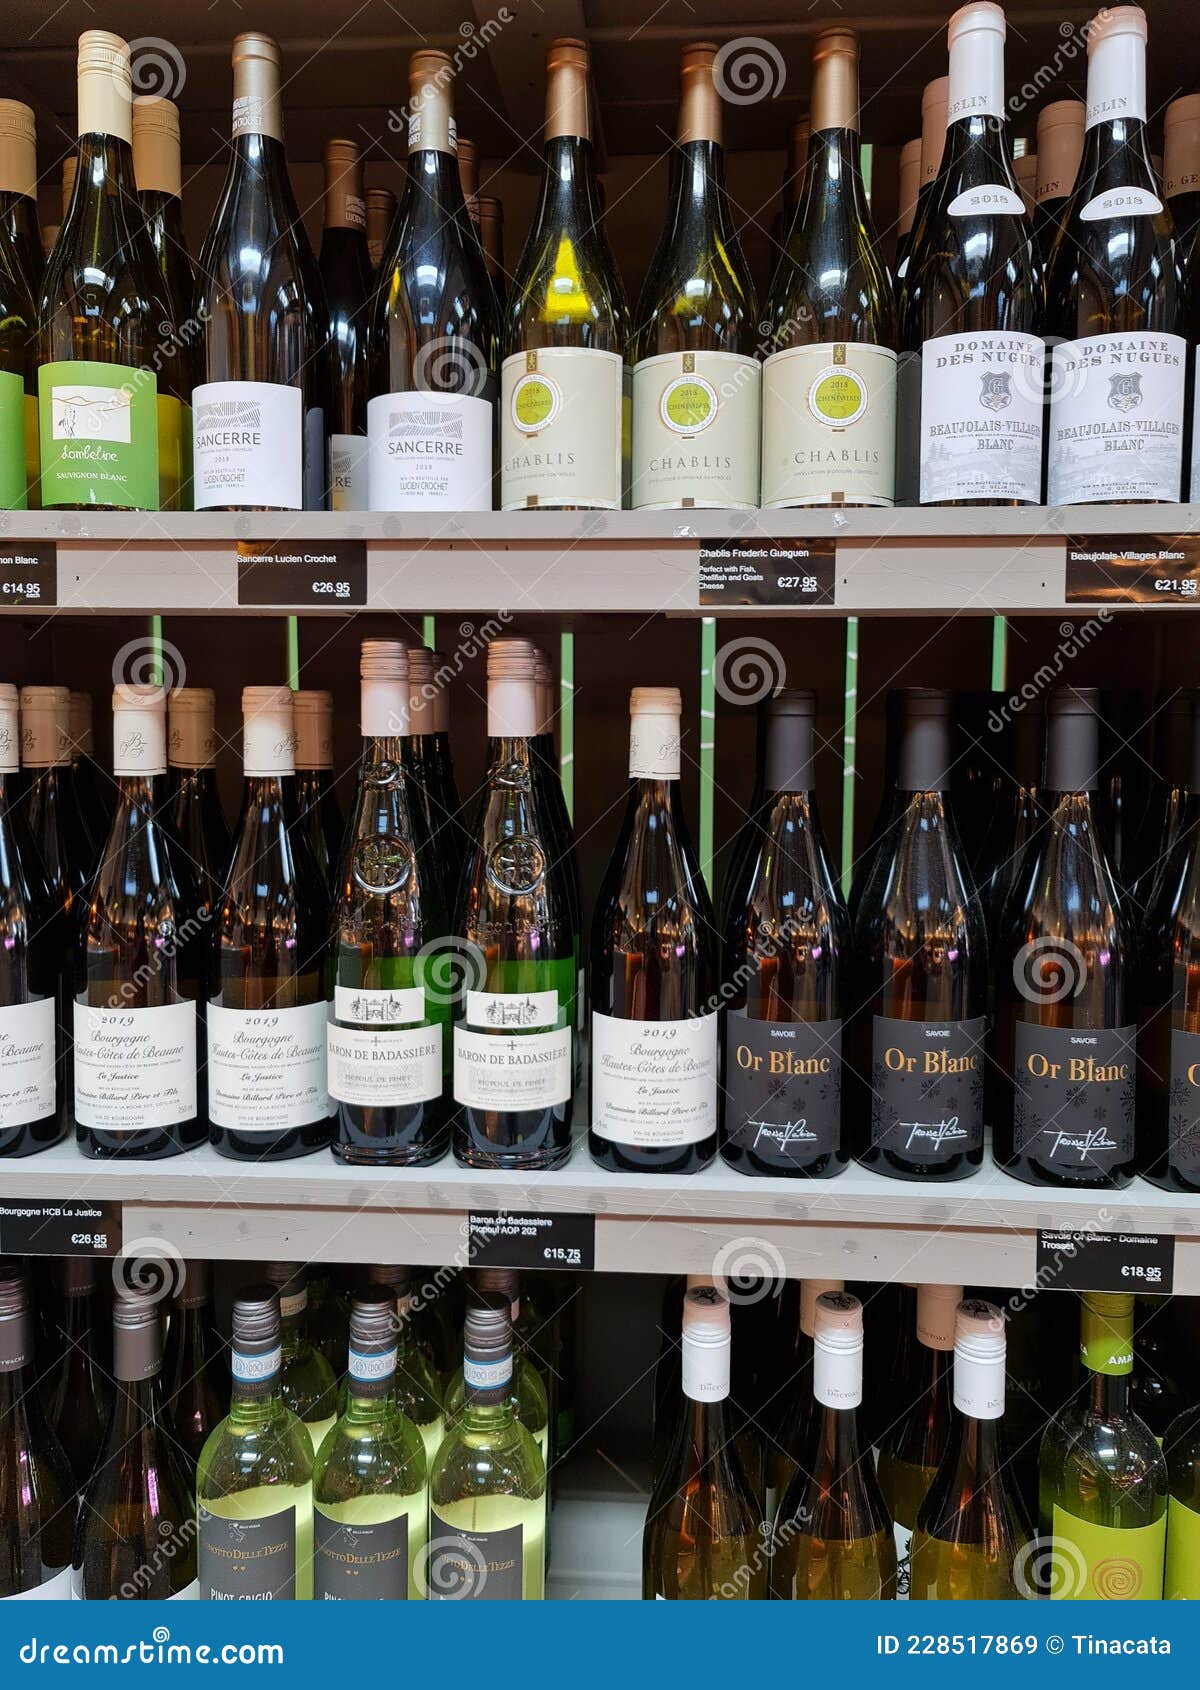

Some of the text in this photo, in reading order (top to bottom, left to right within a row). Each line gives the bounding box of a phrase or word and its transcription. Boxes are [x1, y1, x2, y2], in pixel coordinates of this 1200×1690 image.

[954, 339, 1033, 353] DOMAINE
[1082, 340, 1169, 356] DOMAINE
[936, 351, 1041, 368] DES NUGUES
[1065, 351, 1180, 372] DES NUGUES
[195, 432, 262, 449] SANCERRE
[976, 438, 1014, 450] BLANC
[1103, 439, 1145, 452] BLANC
[388, 440, 464, 456] SANCERRE
[504, 452, 576, 472] CHABLIS
[794, 449, 879, 464] CHABLIS
[649, 455, 731, 472] CHABLIS
[56, 472, 127, 482] SAUVIGNON BLANC
[236, 554, 337, 564] Sancerre Lucien Crochet
[698, 549, 809, 559] Chablis Frederic Gueguen
[1070, 550, 1185, 562] Beaujolais-Villages Blanc
[14, 556, 38, 565] Blanc
[698, 565, 757, 575] Perfect with Fish,
[698, 573, 764, 581] Shellfish and Goats
[777, 576, 817, 588] €27.95
[2, 582, 41, 594] €14.95
[312, 582, 351, 594] €26.95
[698, 582, 724, 590] Cheese
[1154, 579, 1198, 591] €21.95
[101, 1016, 135, 1027] 2019
[245, 1017, 279, 1028] 2019
[91, 1030, 150, 1047] Bourgogne
[233, 1031, 296, 1048] Bourgogne
[642, 1028, 677, 1040] 2019
[770, 1029, 796, 1038] SAVOIE
[1070, 1037, 1097, 1045] SAVOIE
[126, 1047, 140, 1060] de
[143, 1045, 184, 1059] Beaune
[271, 1047, 284, 1060] de
[354, 1049, 369, 1060] DE
[457, 1047, 487, 1063] BARON
[489, 1054, 505, 1065] DE
[629, 1042, 690, 1060] Bourgogne
[736, 1045, 831, 1075] Or Blanc
[884, 1046, 978, 1075] Or Blanc
[668, 1060, 681, 1073] de
[1027, 1053, 1129, 1082] Or Blanc
[97, 1071, 140, 1082] La Justice
[240, 1073, 284, 1082] La Justice
[99, 1093, 129, 1101] Billard
[637, 1085, 680, 1097] La Justice
[242, 1093, 273, 1102] Billard
[0, 1207, 103, 1218] Bourgogne HCB La Justice
[469, 1215, 553, 1227] Baron de Badassiere
[501, 1226, 521, 1235] AOP
[521, 1226, 537, 1236] 202
[1041, 1230, 1072, 1240] Savoie
[1086, 1232, 1112, 1242] Blanc
[1119, 1234, 1159, 1244] Domaine
[71, 1234, 108, 1245] €26.95
[1041, 1240, 1075, 1250] Trosset
[543, 1247, 581, 1259] €15.75
[1121, 1265, 1162, 1277] €18.95
